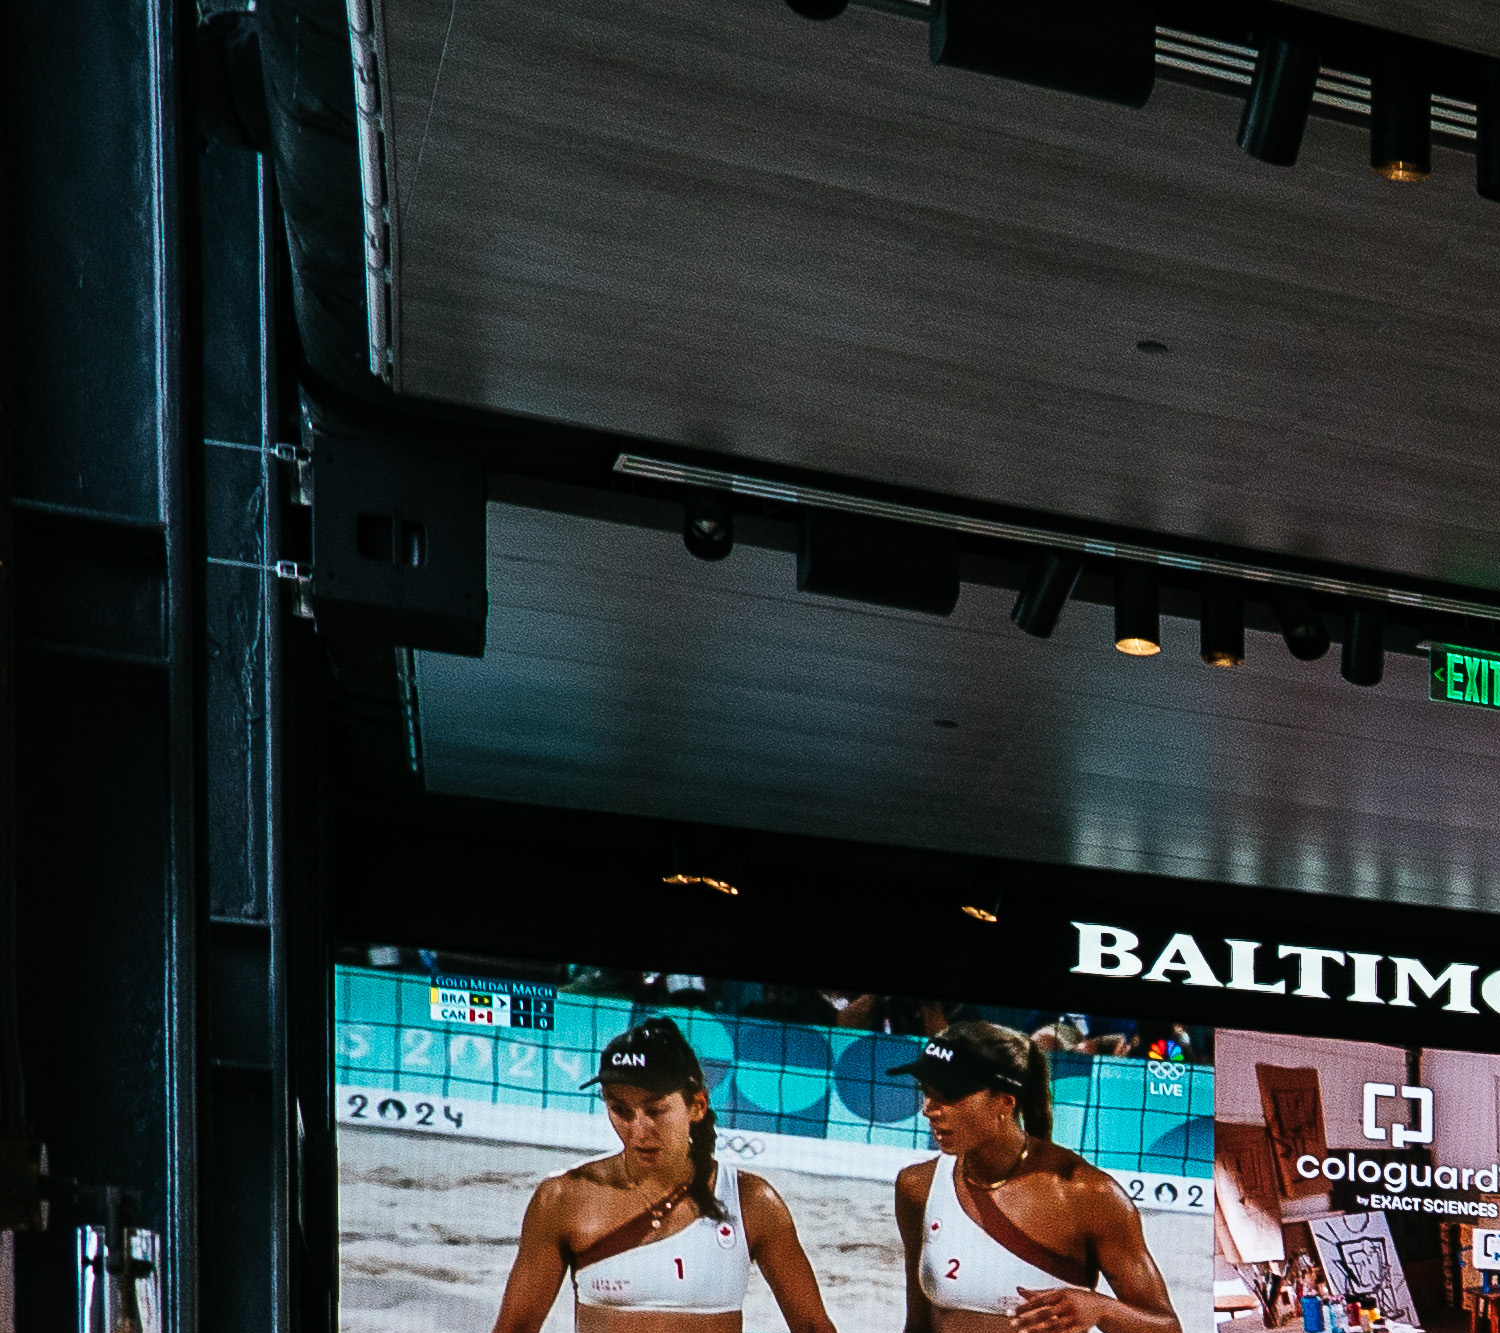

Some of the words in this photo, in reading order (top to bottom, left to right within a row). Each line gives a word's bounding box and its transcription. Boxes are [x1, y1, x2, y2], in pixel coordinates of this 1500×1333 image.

[435, 976, 468, 990] GOLD
[470, 978, 508, 993] MEDAL
[512, 982, 553, 998] MATCH
[441, 993, 466, 1005] BRA
[441, 1008, 467, 1021] CAN
[612, 1052, 646, 1067] CAN
[925, 1042, 954, 1062] CAN
[1149, 1081, 1184, 1097] LIVE
[348, 1094, 463, 1129] 2024
[1296, 1151, 1499, 1193] cologuard
[1356, 1195, 1369, 1206] by
[1370, 1193, 1421, 1212] EXACT
[1423, 1198, 1499, 1218] SCIENCES
[674, 1257, 684, 1280] 1
[944, 1257, 961, 1280] 2
